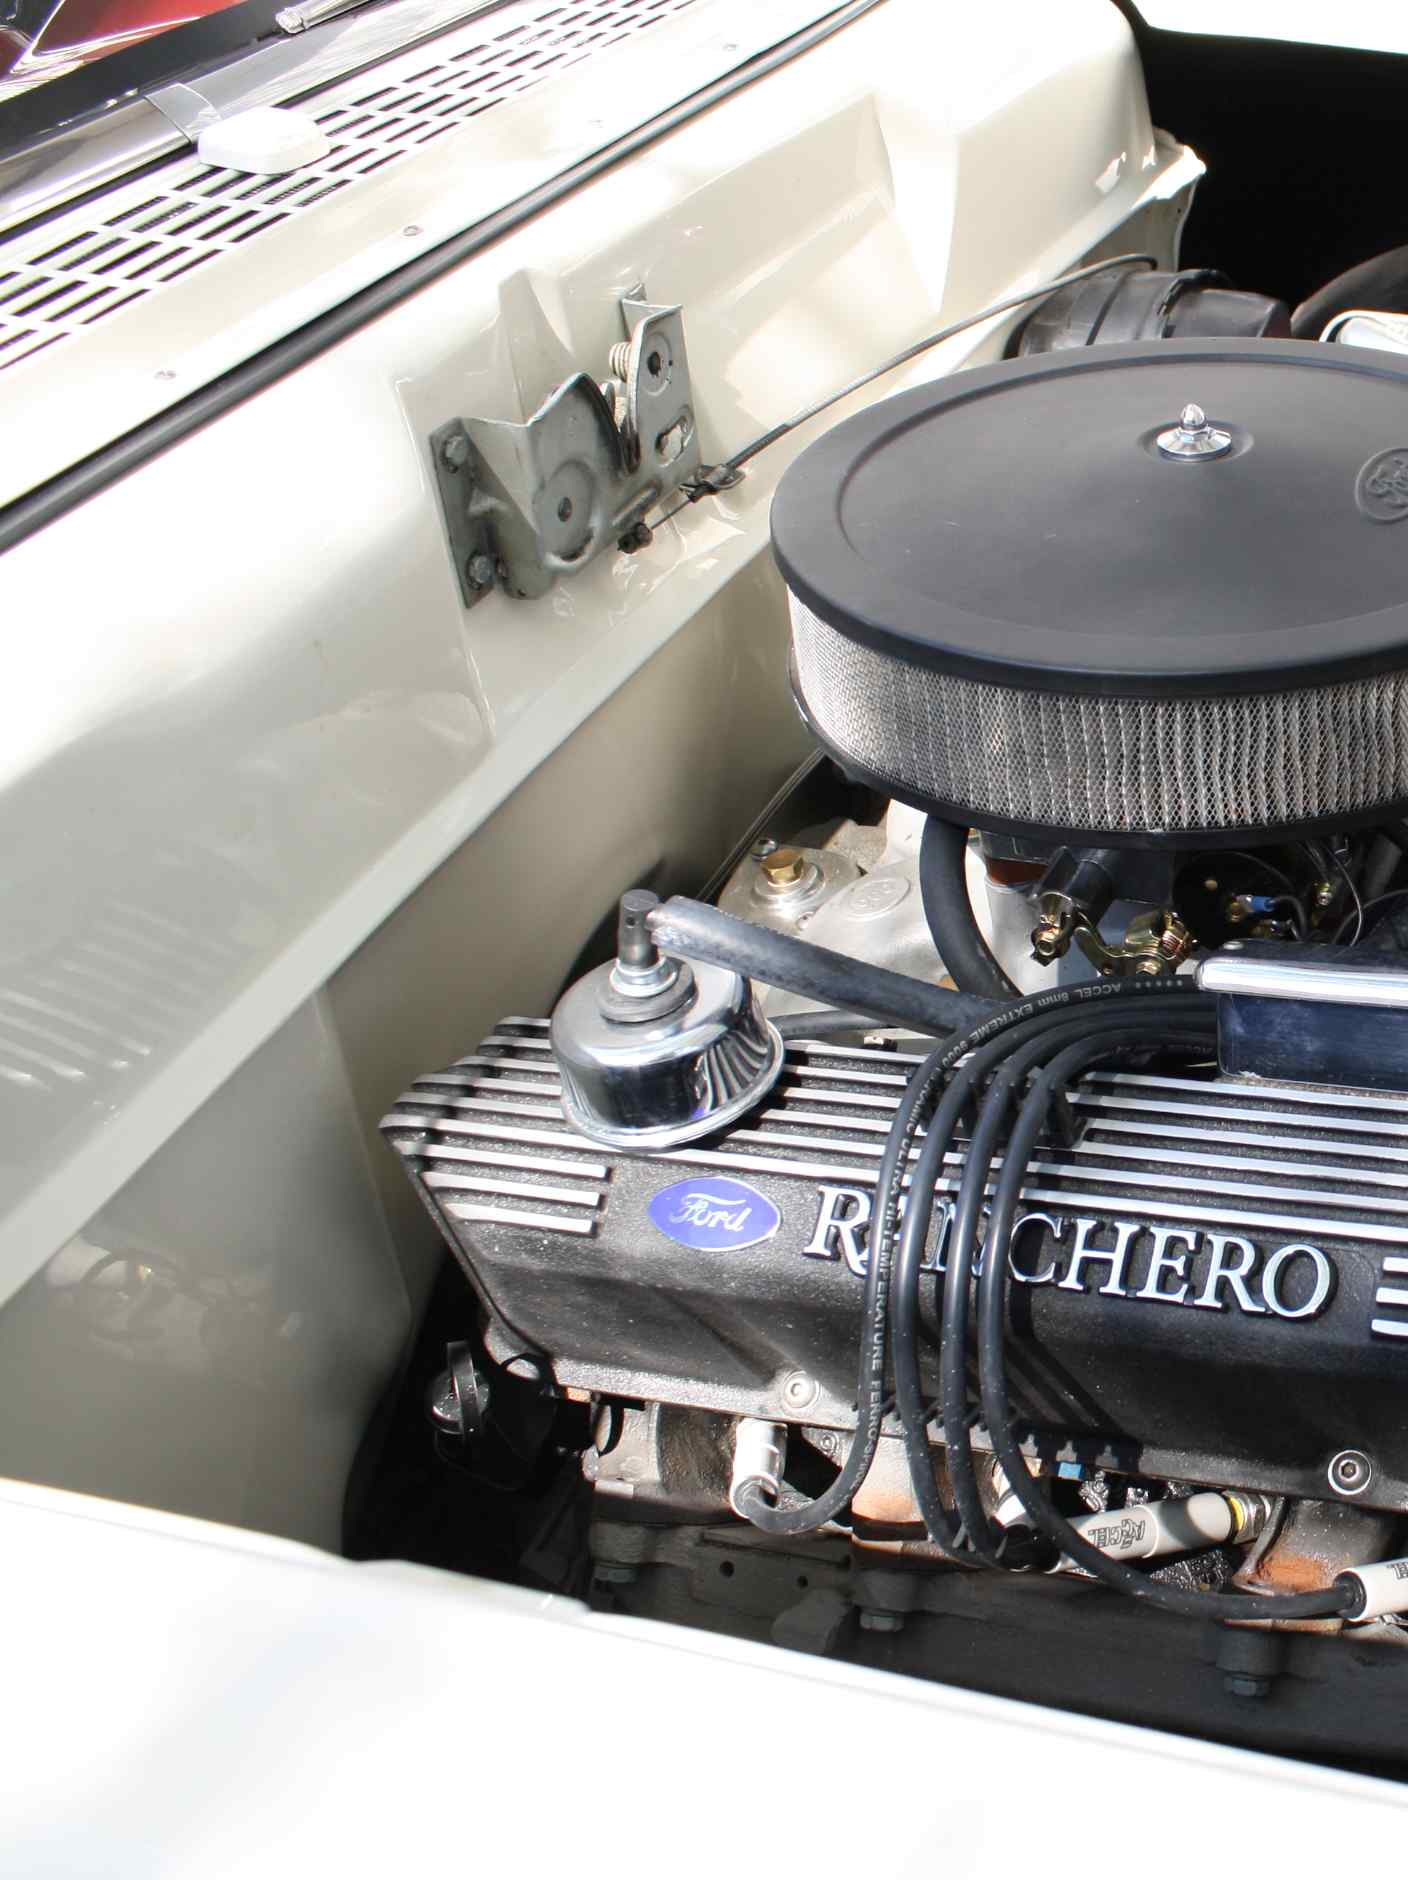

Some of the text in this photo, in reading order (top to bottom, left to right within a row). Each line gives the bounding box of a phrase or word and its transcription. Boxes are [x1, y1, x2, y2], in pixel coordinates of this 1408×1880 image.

[1037, 991, 1070, 1007] 8mm
[1074, 983, 1122, 1000] ACCEL
[968, 1003, 1034, 1043] EXTREME
[670, 1191, 746, 1233] Ford
[871, 1201, 898, 1371] HI-TEMPERATURE
[1088, 1519, 1146, 1551] ACCEL
